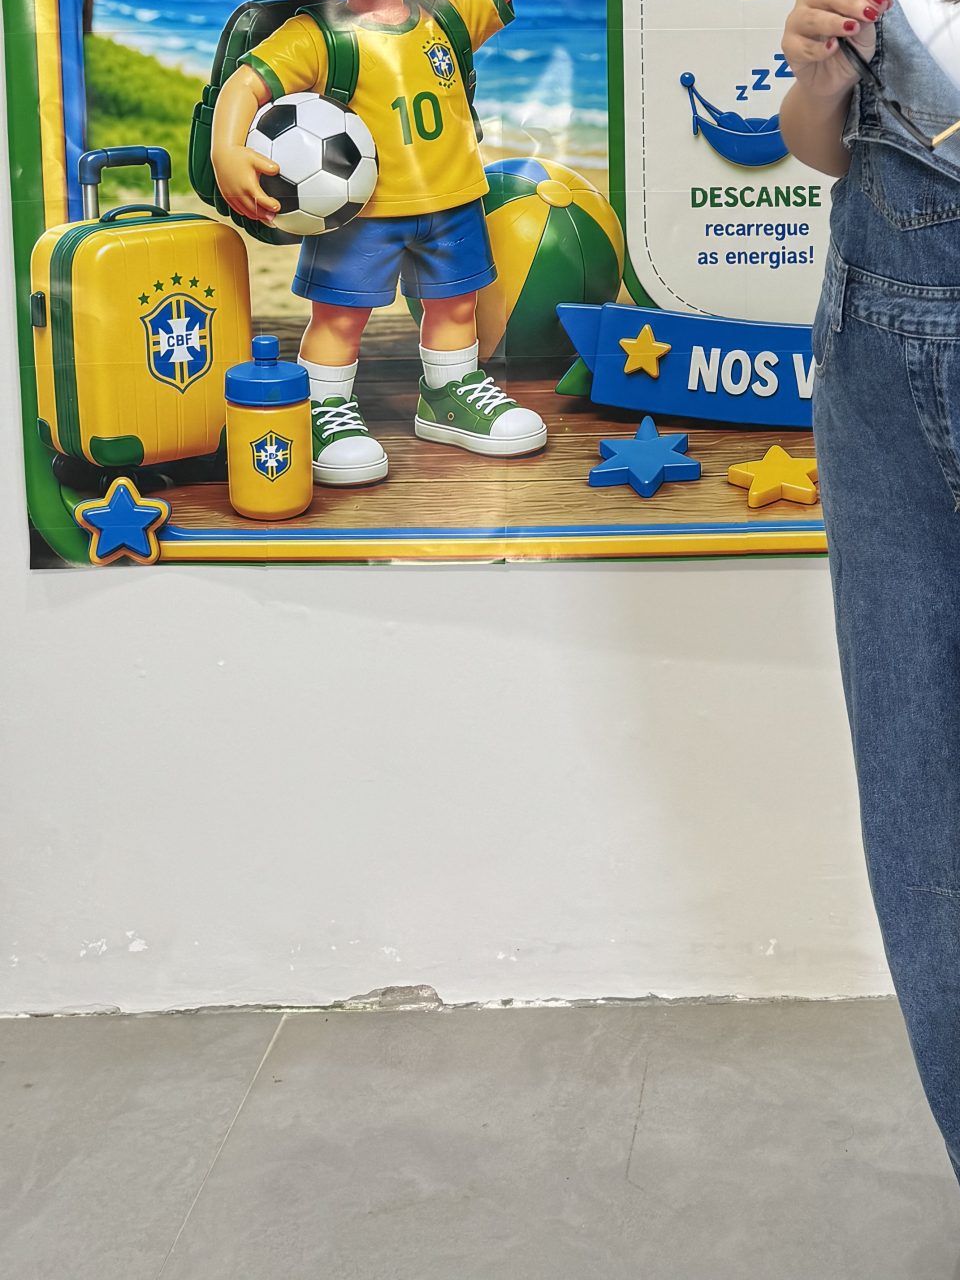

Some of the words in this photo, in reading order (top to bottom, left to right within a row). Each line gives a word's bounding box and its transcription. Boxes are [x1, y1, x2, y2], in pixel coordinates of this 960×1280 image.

[391, 91, 443, 145] 10
[691, 186, 822, 208] DESCANSE
[705, 223, 809, 240] recarregue
[698, 251, 719, 264] as
[725, 246, 814, 269] energias!
[166, 331, 193, 349] CBF
[687, 345, 779, 397] NOS
